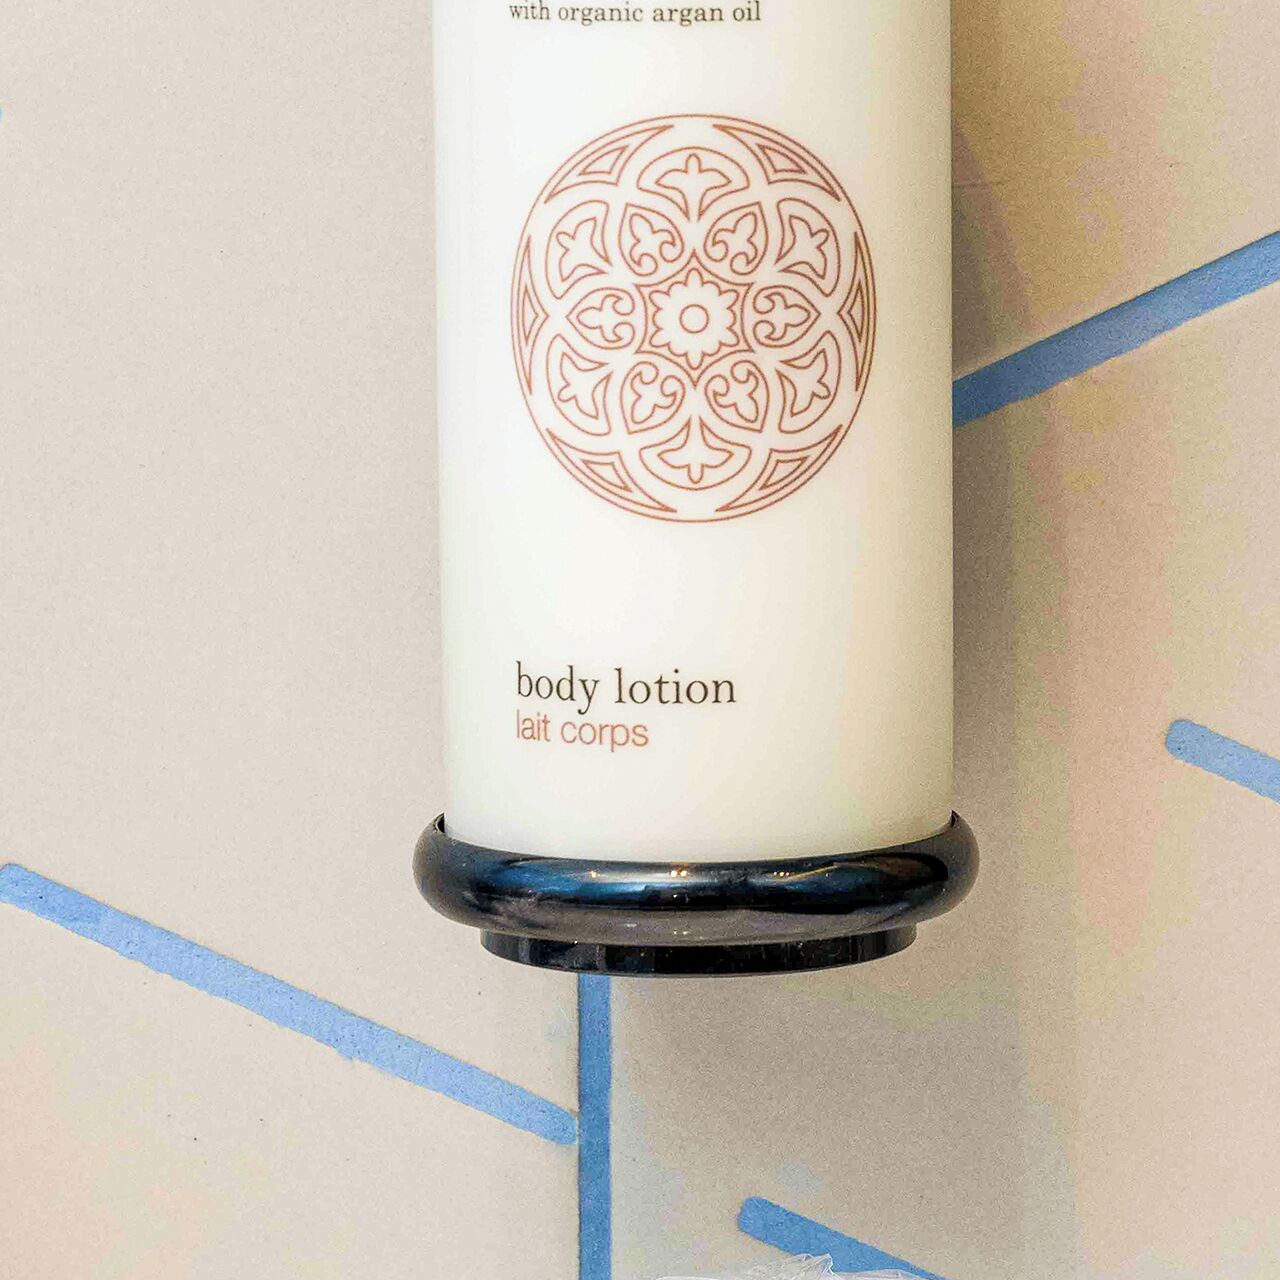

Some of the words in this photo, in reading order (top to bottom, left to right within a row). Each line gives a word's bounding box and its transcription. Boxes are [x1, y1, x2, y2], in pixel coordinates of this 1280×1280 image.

[508, 0, 551, 22] with
[557, 1, 644, 26] organic
[652, 5, 724, 27] argan
[732, 0, 762, 22] oil
[515, 660, 600, 715] body
[614, 667, 737, 705] lotion
[515, 709, 552, 743] lait
[560, 719, 650, 753] corps
